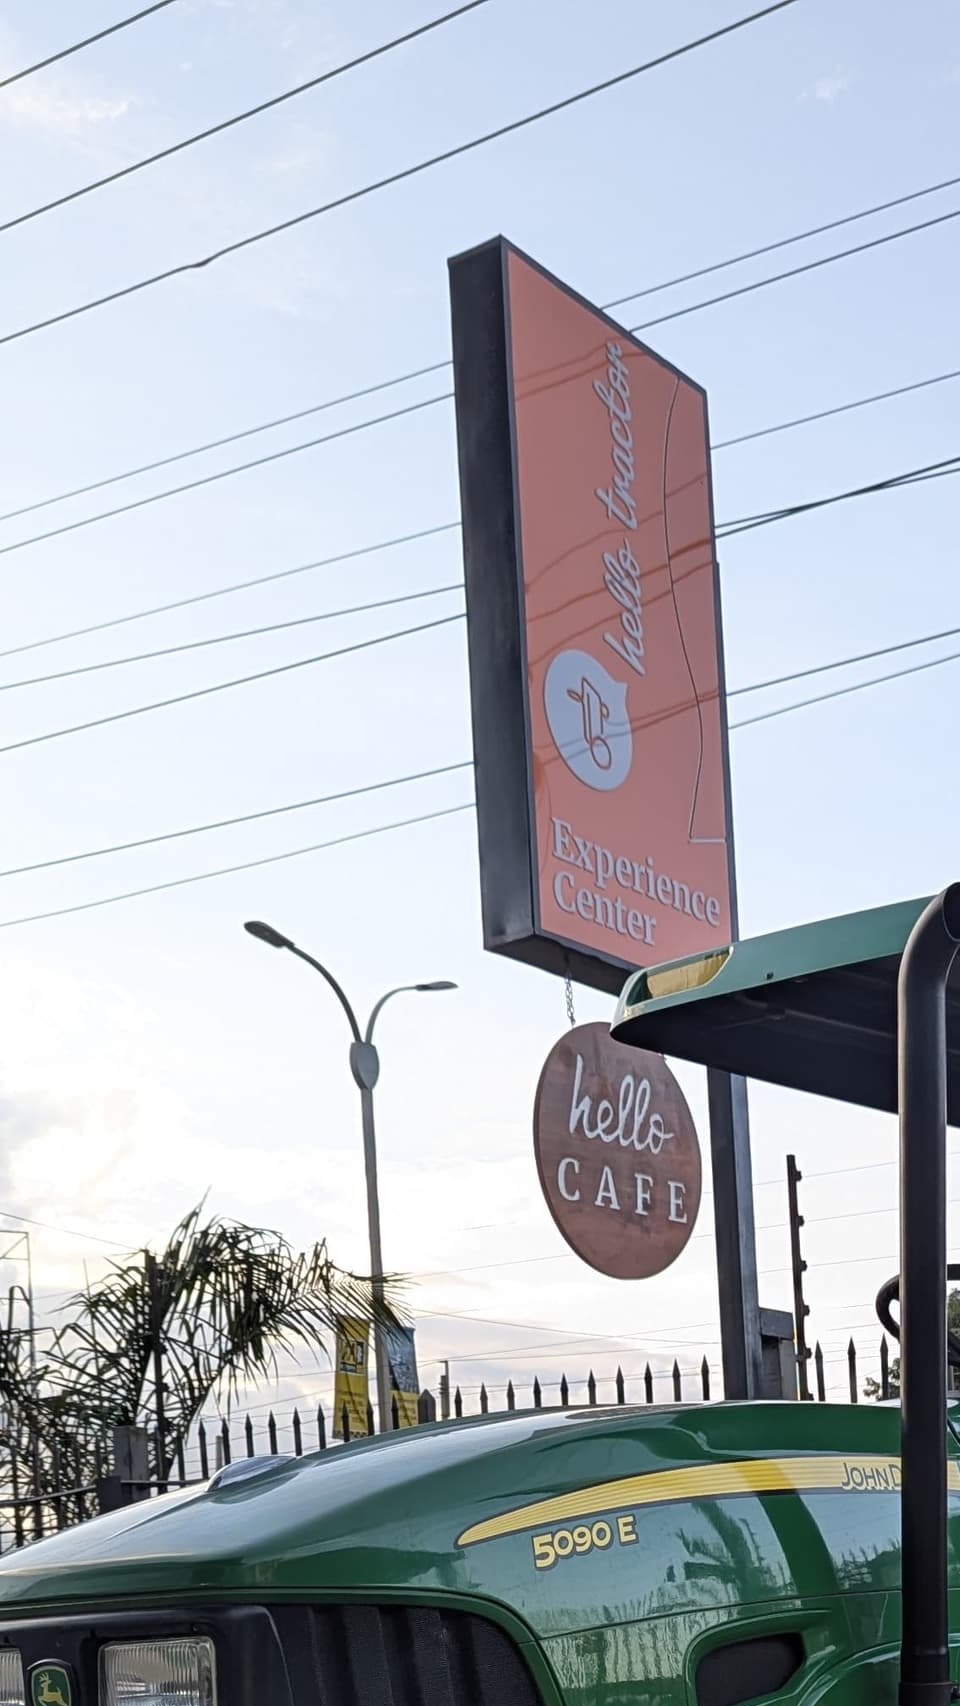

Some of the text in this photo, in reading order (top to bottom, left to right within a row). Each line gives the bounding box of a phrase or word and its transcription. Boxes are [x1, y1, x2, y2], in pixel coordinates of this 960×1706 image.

[592, 341, 646, 676] hello tractor
[551, 816, 721, 928] Experience
[553, 870, 657, 946] Center
[569, 1053, 675, 1155] hello
[557, 1157, 688, 1224] CAFE
[841, 1460, 890, 1487] JOHN
[531, 1515, 638, 1570] 5090 E
